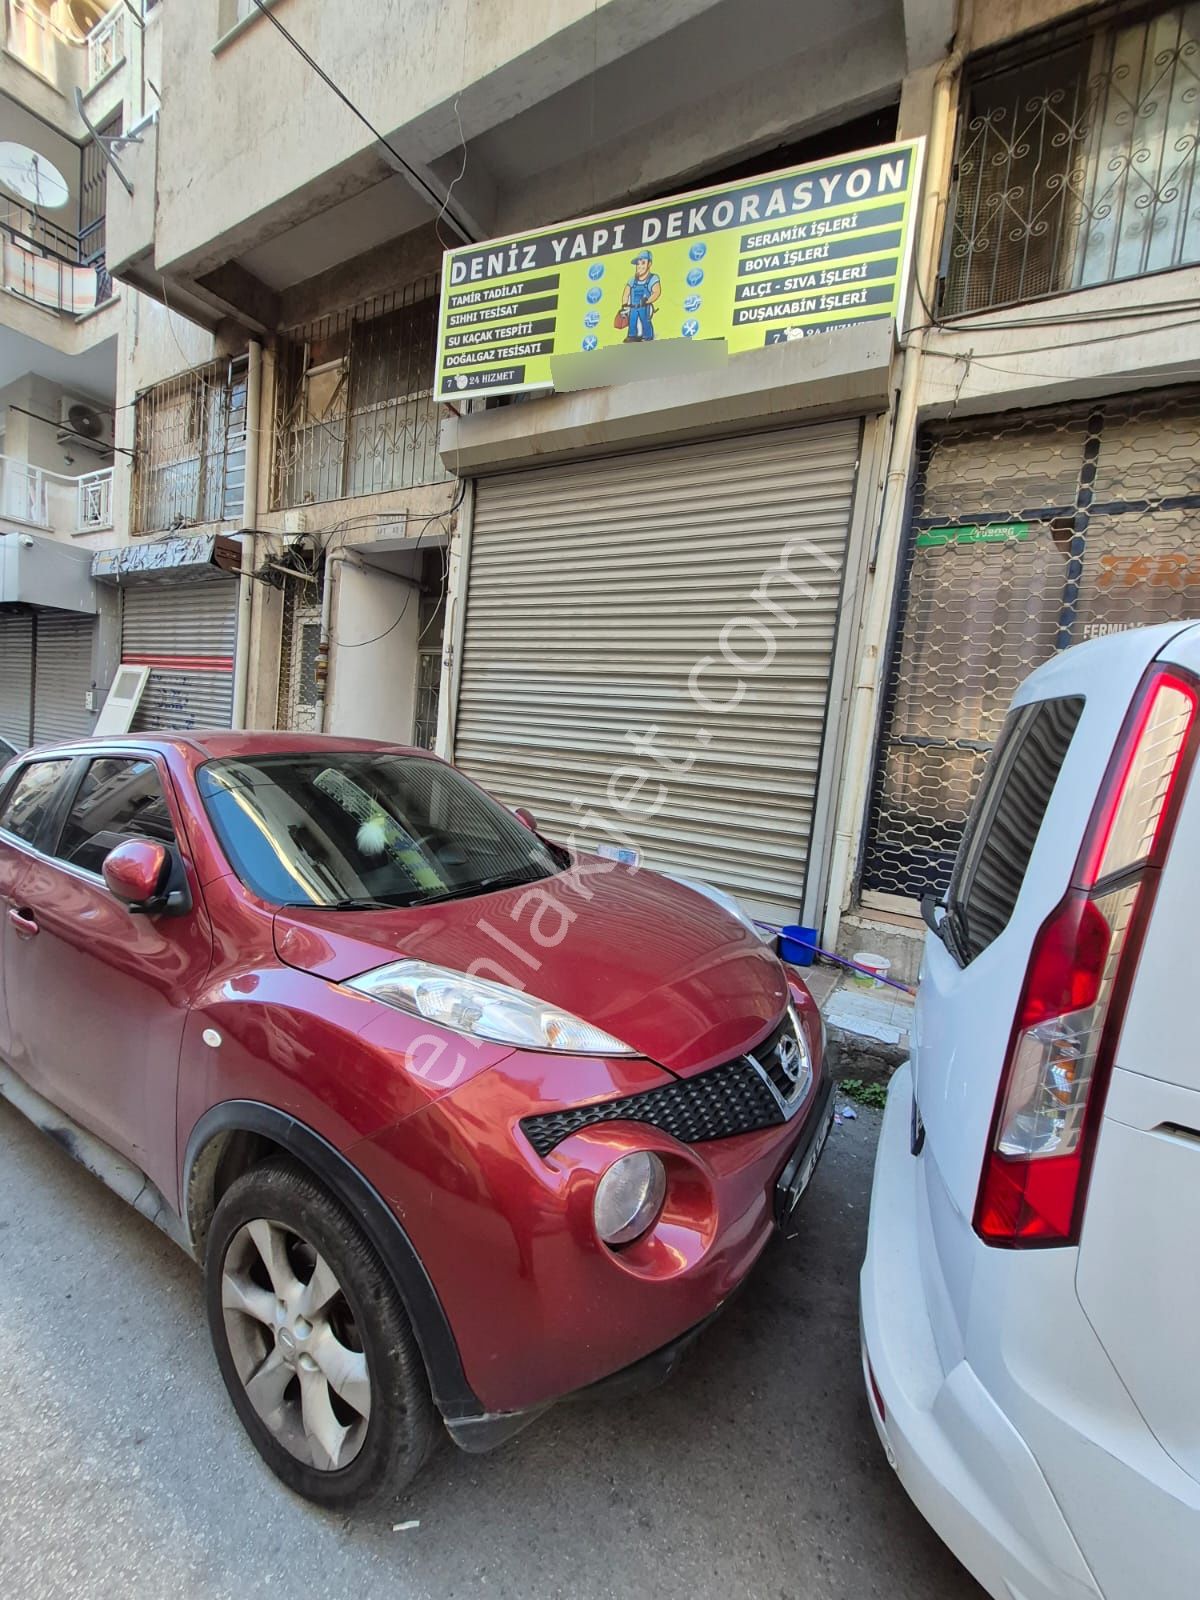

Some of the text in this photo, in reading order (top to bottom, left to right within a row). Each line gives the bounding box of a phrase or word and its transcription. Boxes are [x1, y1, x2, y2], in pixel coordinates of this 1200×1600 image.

[450, 159, 905, 284] DENİZ YAPI DEKORASYON
[746, 213, 858, 249] SERAMİK İŞLERİ
[744, 244, 829, 272] BOYA İŞLERİ
[740, 283, 772, 300] ALÇI
[783, 271, 817, 291] SIVA
[820, 263, 868, 287] İŞLERİ
[451, 284, 524, 306] TAMİR TADİLAT
[738, 290, 868, 322] DUŞAKABİN İŞLERİ
[449, 304, 519, 325] SIHHI TESİSAT
[448, 322, 533, 347] SU KAÇAK TESPİTİ
[773, 334, 781, 344] 7
[446, 342, 542, 366] DOĞALGAZ TESİSATI
[446, 379, 453, 388] 7
[469, 376, 481, 385] 24
